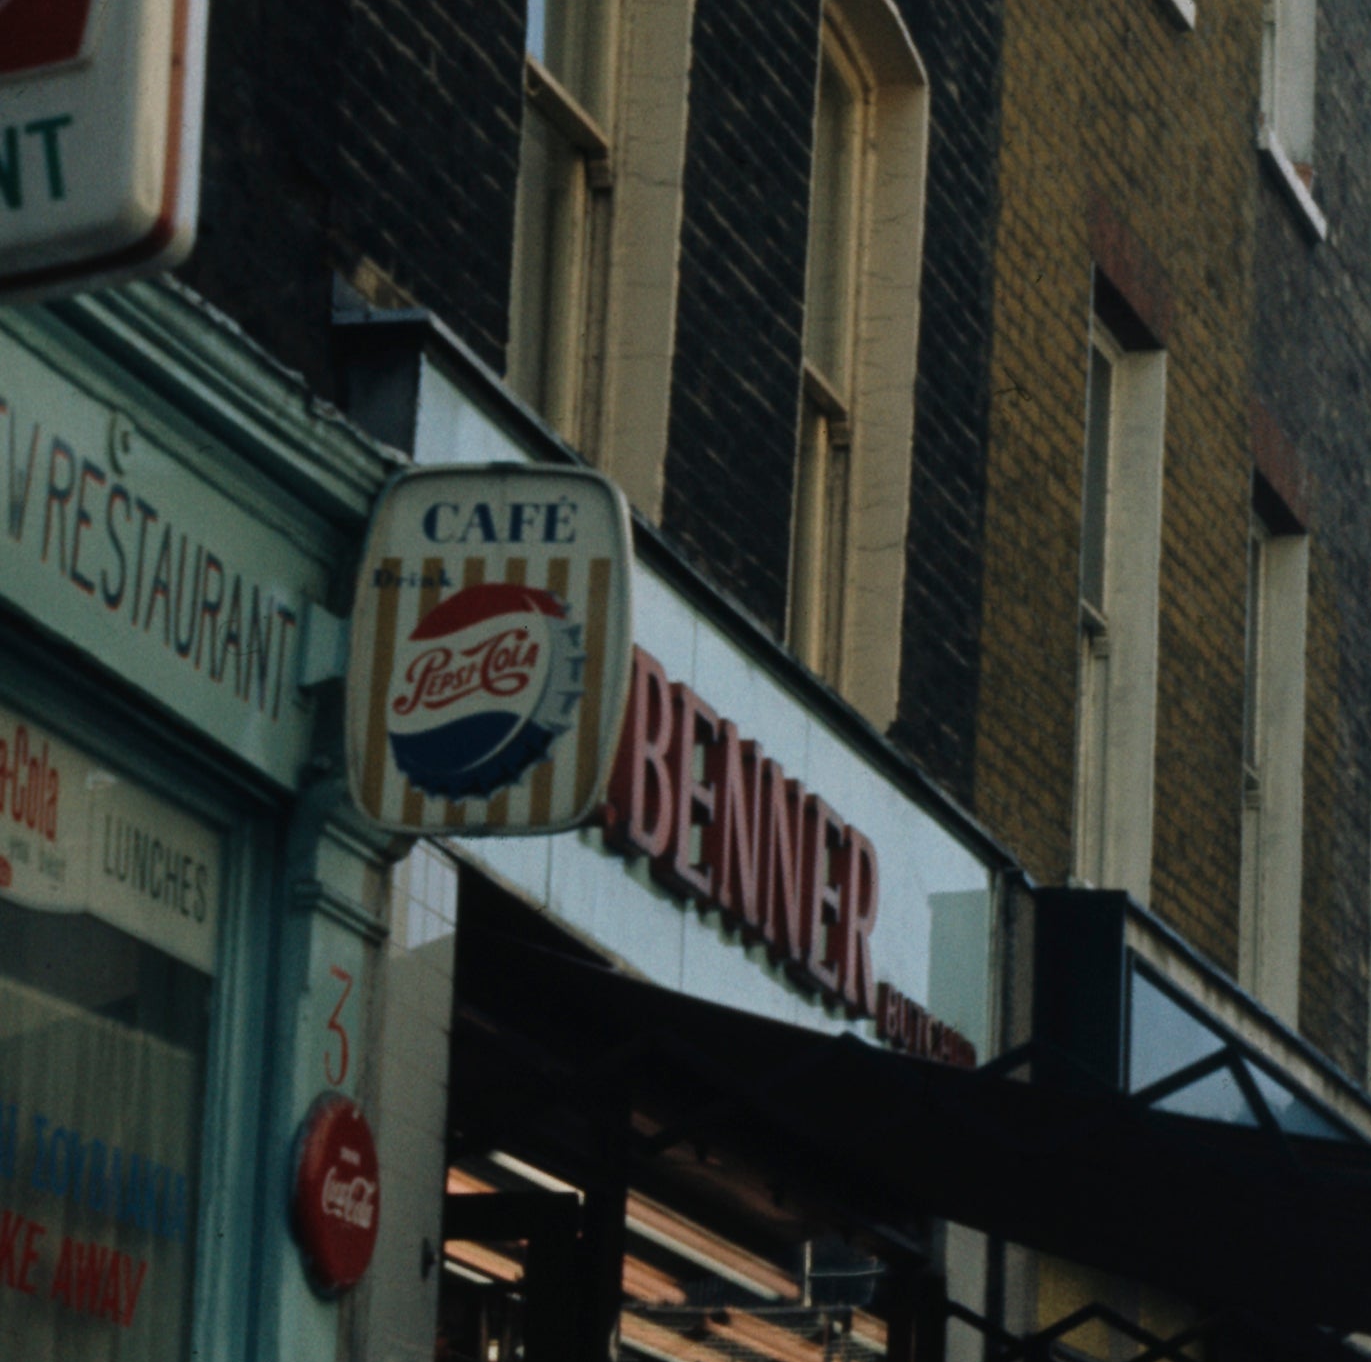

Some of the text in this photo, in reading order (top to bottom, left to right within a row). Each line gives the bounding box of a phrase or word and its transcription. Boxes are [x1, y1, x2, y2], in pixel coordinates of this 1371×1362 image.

[41, 435, 296, 723] RESTAURANT
[372, 567, 453, 589] Drink
[103, 814, 207, 925] LUNCHES
[628, 642, 880, 1019] BENNER
[323, 963, 354, 1086] 3
[51, 1236, 148, 1329] AWAY
